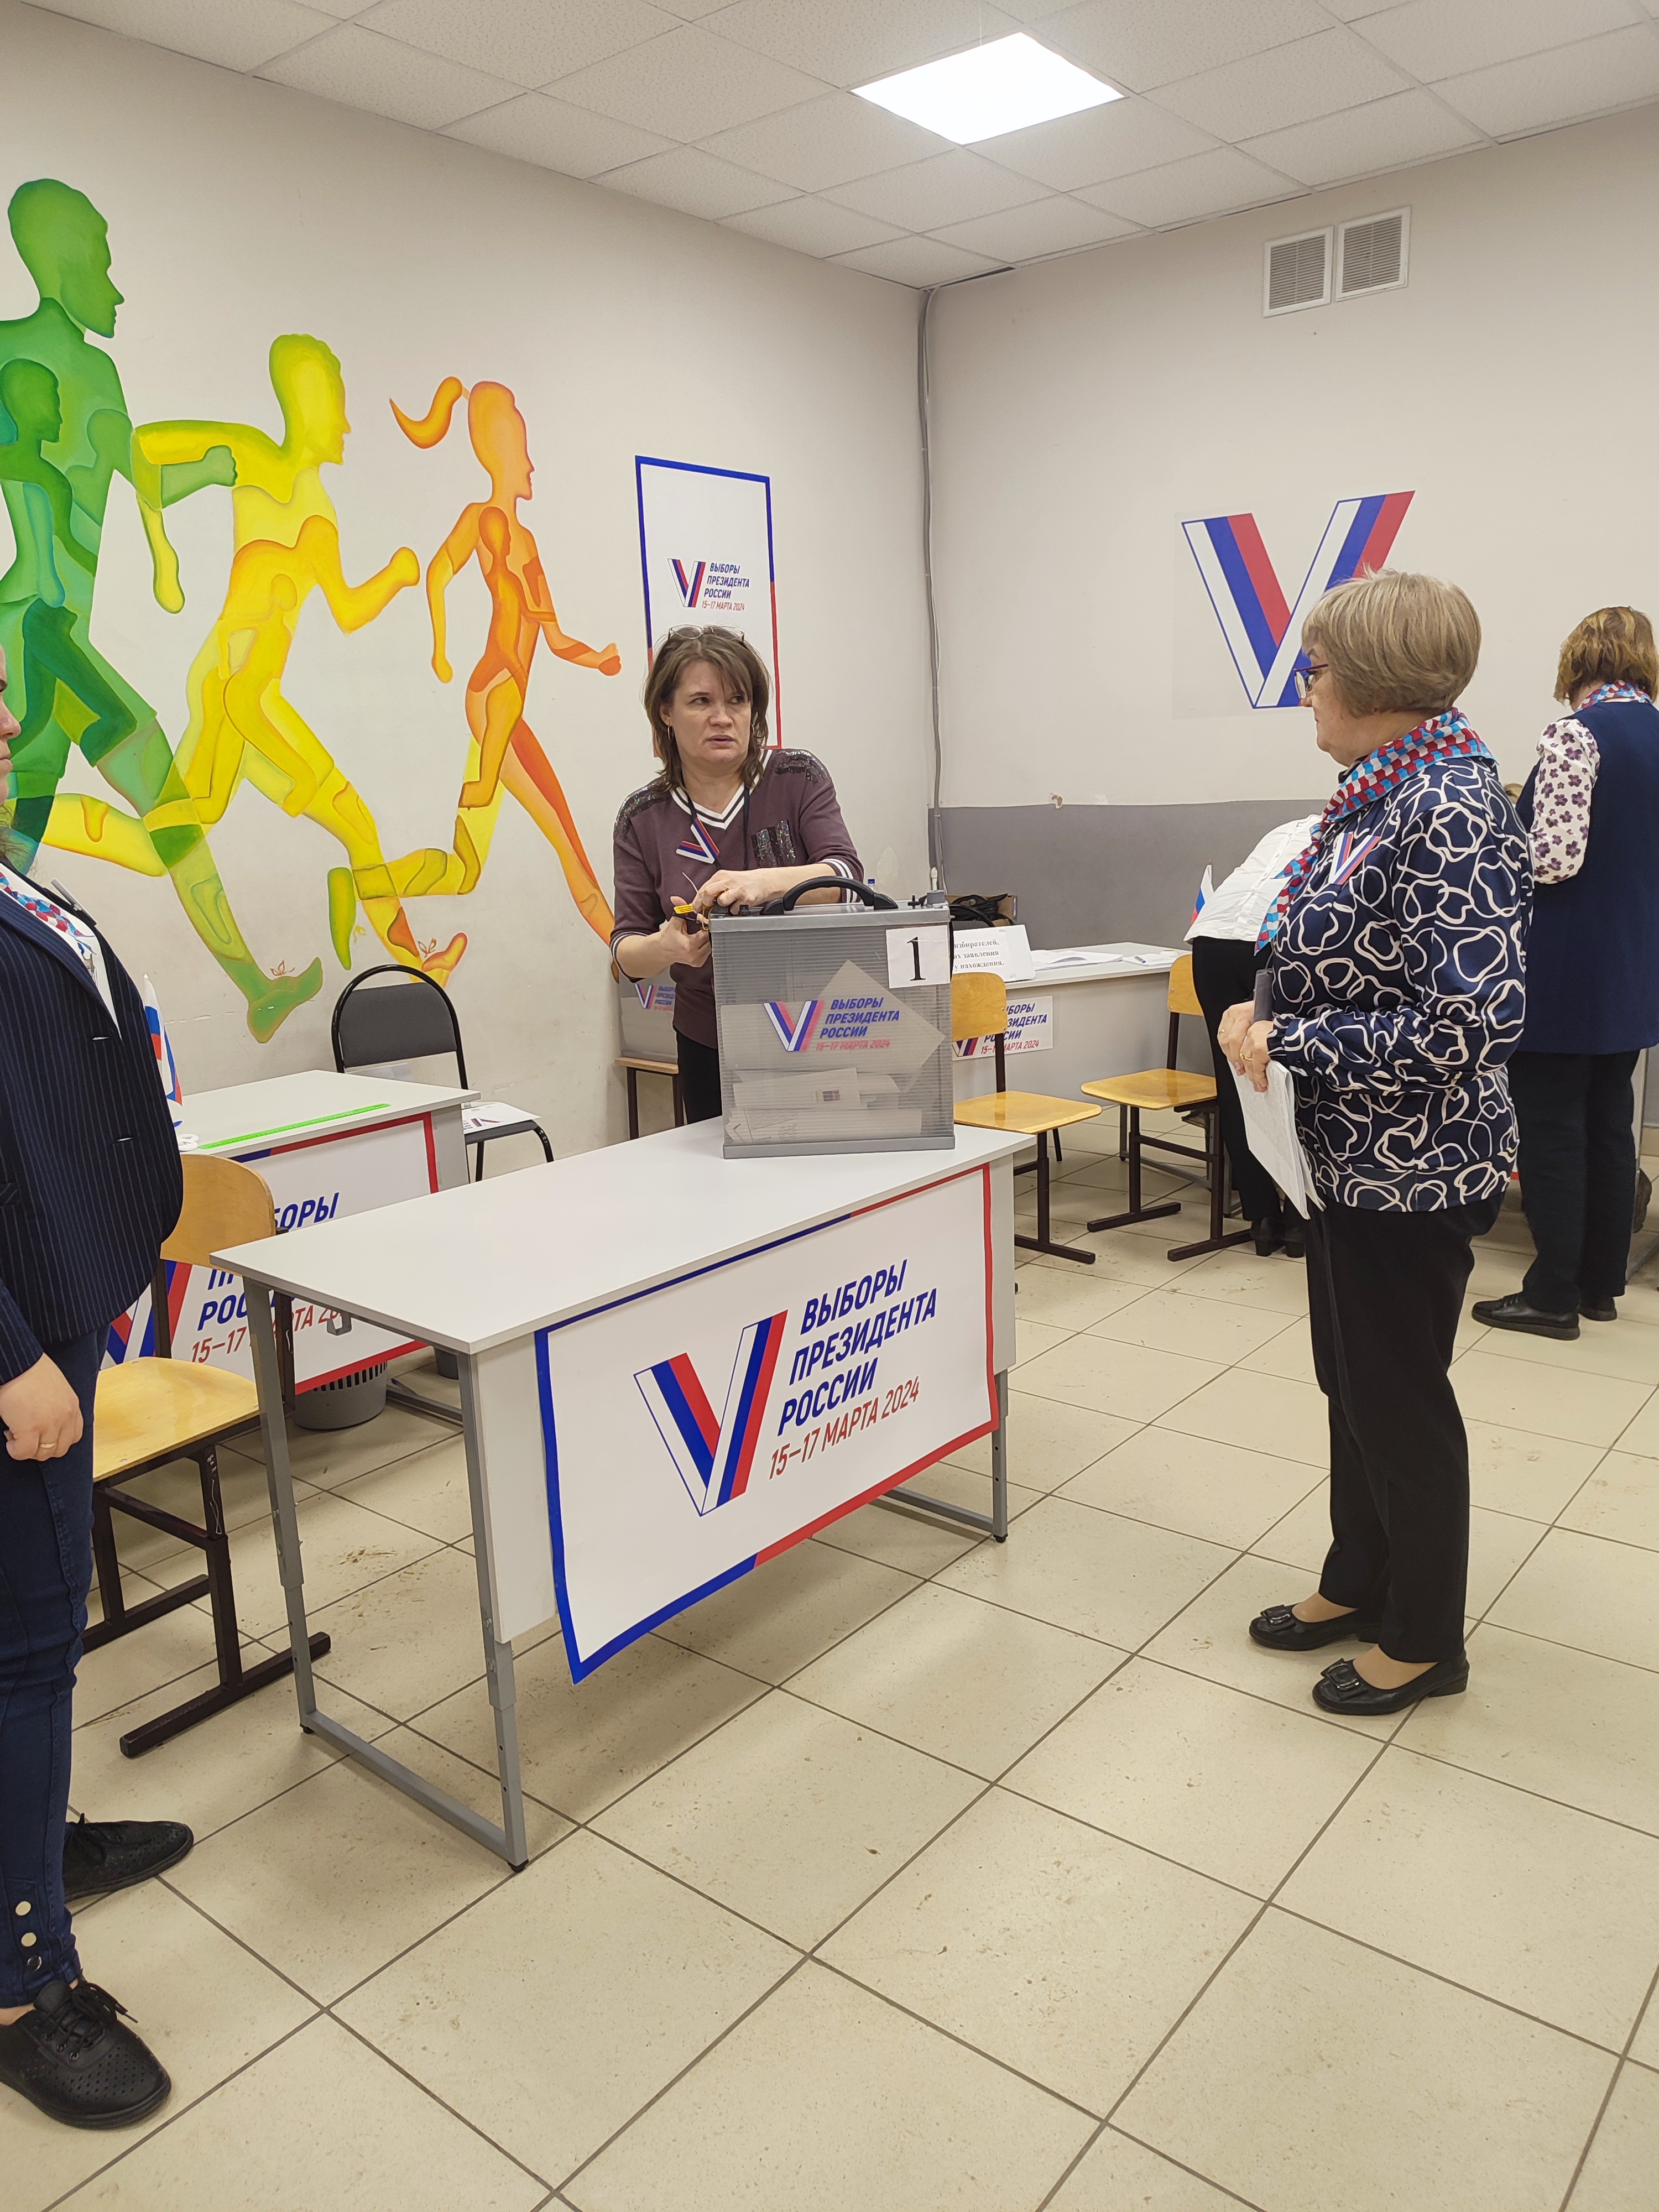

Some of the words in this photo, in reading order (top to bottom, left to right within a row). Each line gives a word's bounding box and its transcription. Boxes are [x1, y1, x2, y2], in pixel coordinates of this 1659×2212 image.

[709, 562, 740, 575] ВЫБОРЫ
[706, 575, 750, 588] ПРЕЗИДЕНТА
[703, 588, 732, 599] РОССИИ
[716, 601, 732, 611] МАРТА
[733, 603, 745, 611] 2024
[907, 936, 926, 981] 1
[830, 997, 884, 1010] ВЫБОРЫ
[1006, 1003, 1035, 1015] БОРЫ
[825, 1010, 900, 1024] ПРЕЗИДЕНТА
[1007, 1014, 1047, 1027] ЗИДЕНТА
[820, 1026, 868, 1039] РОССИИ
[984, 1029, 1022, 1043] РОСИИ
[839, 1040, 869, 1050] МАРТА
[870, 1039, 891, 1048] 2024
[1023, 1039, 1040, 1049] 2024
[800, 1259, 907, 1335] ВЫБОРЫ
[789, 1288, 937, 1386] ПРЕЗИДЕНТА
[778, 1357, 878, 1437] РОССИИ
[821, 1400, 878, 1452] МАРТА
[881, 1376, 919, 1420] 2024
